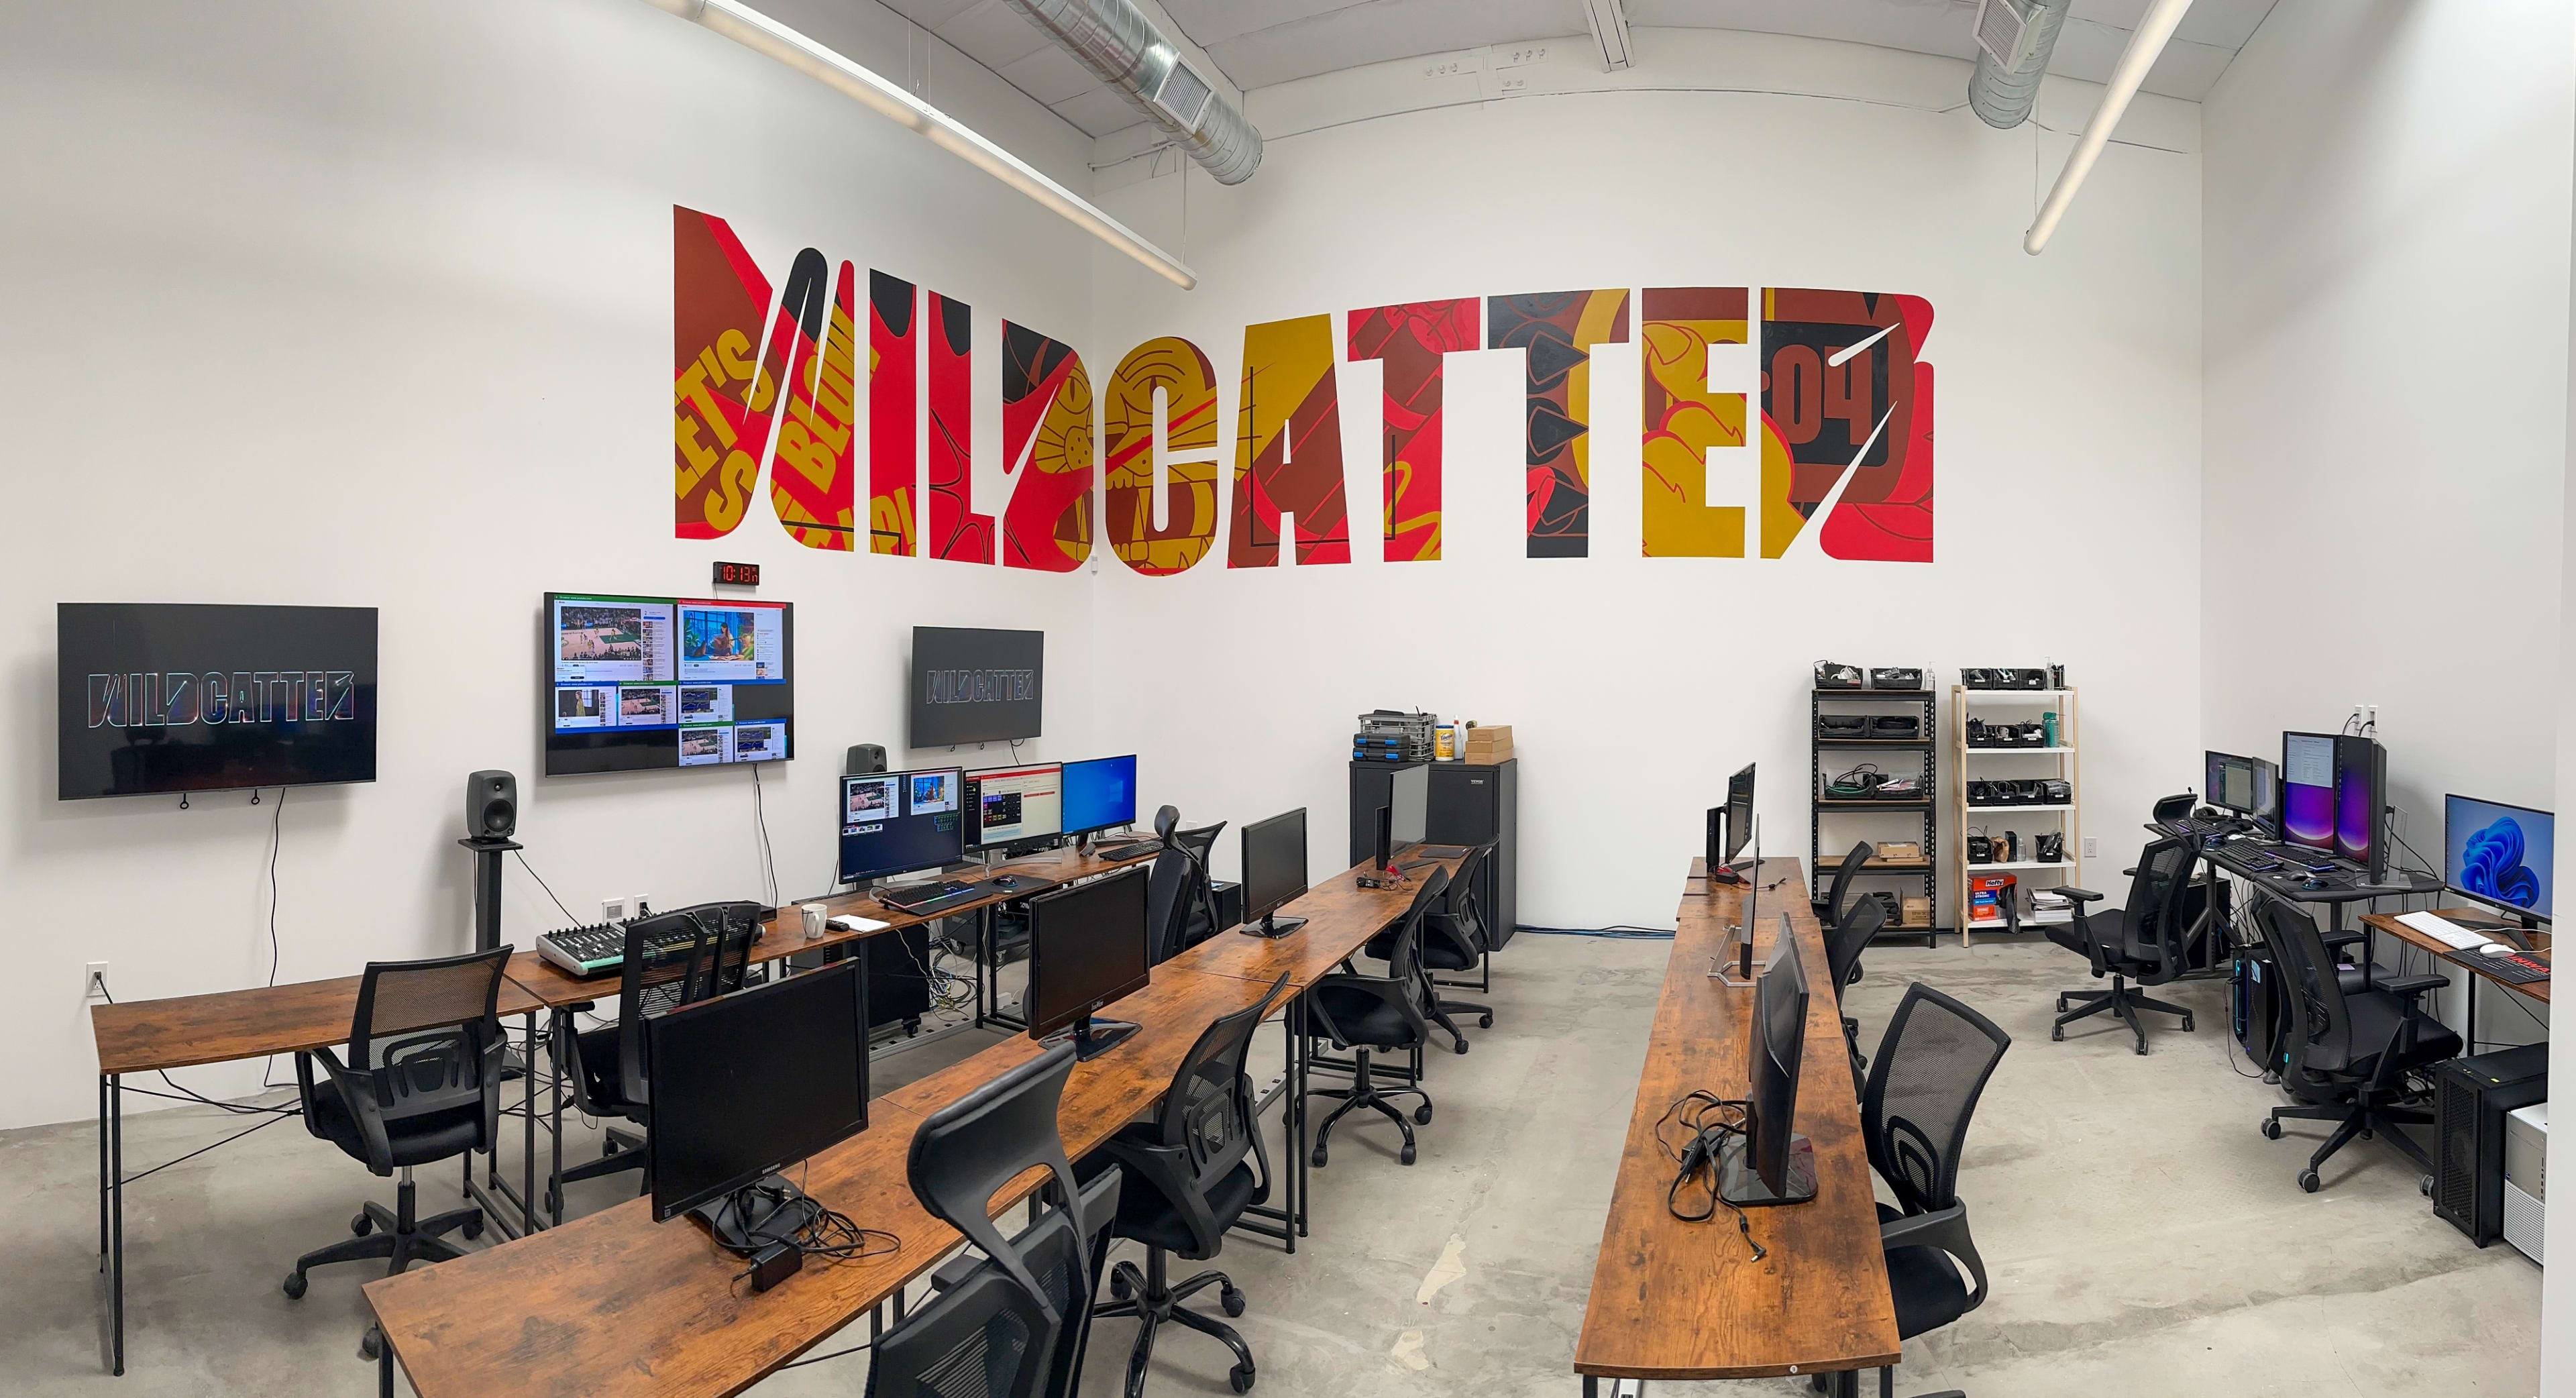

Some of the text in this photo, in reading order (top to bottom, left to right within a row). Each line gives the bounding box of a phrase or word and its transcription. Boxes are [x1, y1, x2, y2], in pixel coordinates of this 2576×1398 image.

[674, 204, 1935, 577] WILDCATTER
[722, 565, 750, 582] 10:13
[88, 671, 354, 729] WILDCATTER
[926, 669, 1034, 704] WILDCATTER
[762, 1163, 781, 1175] SAMSUNG
